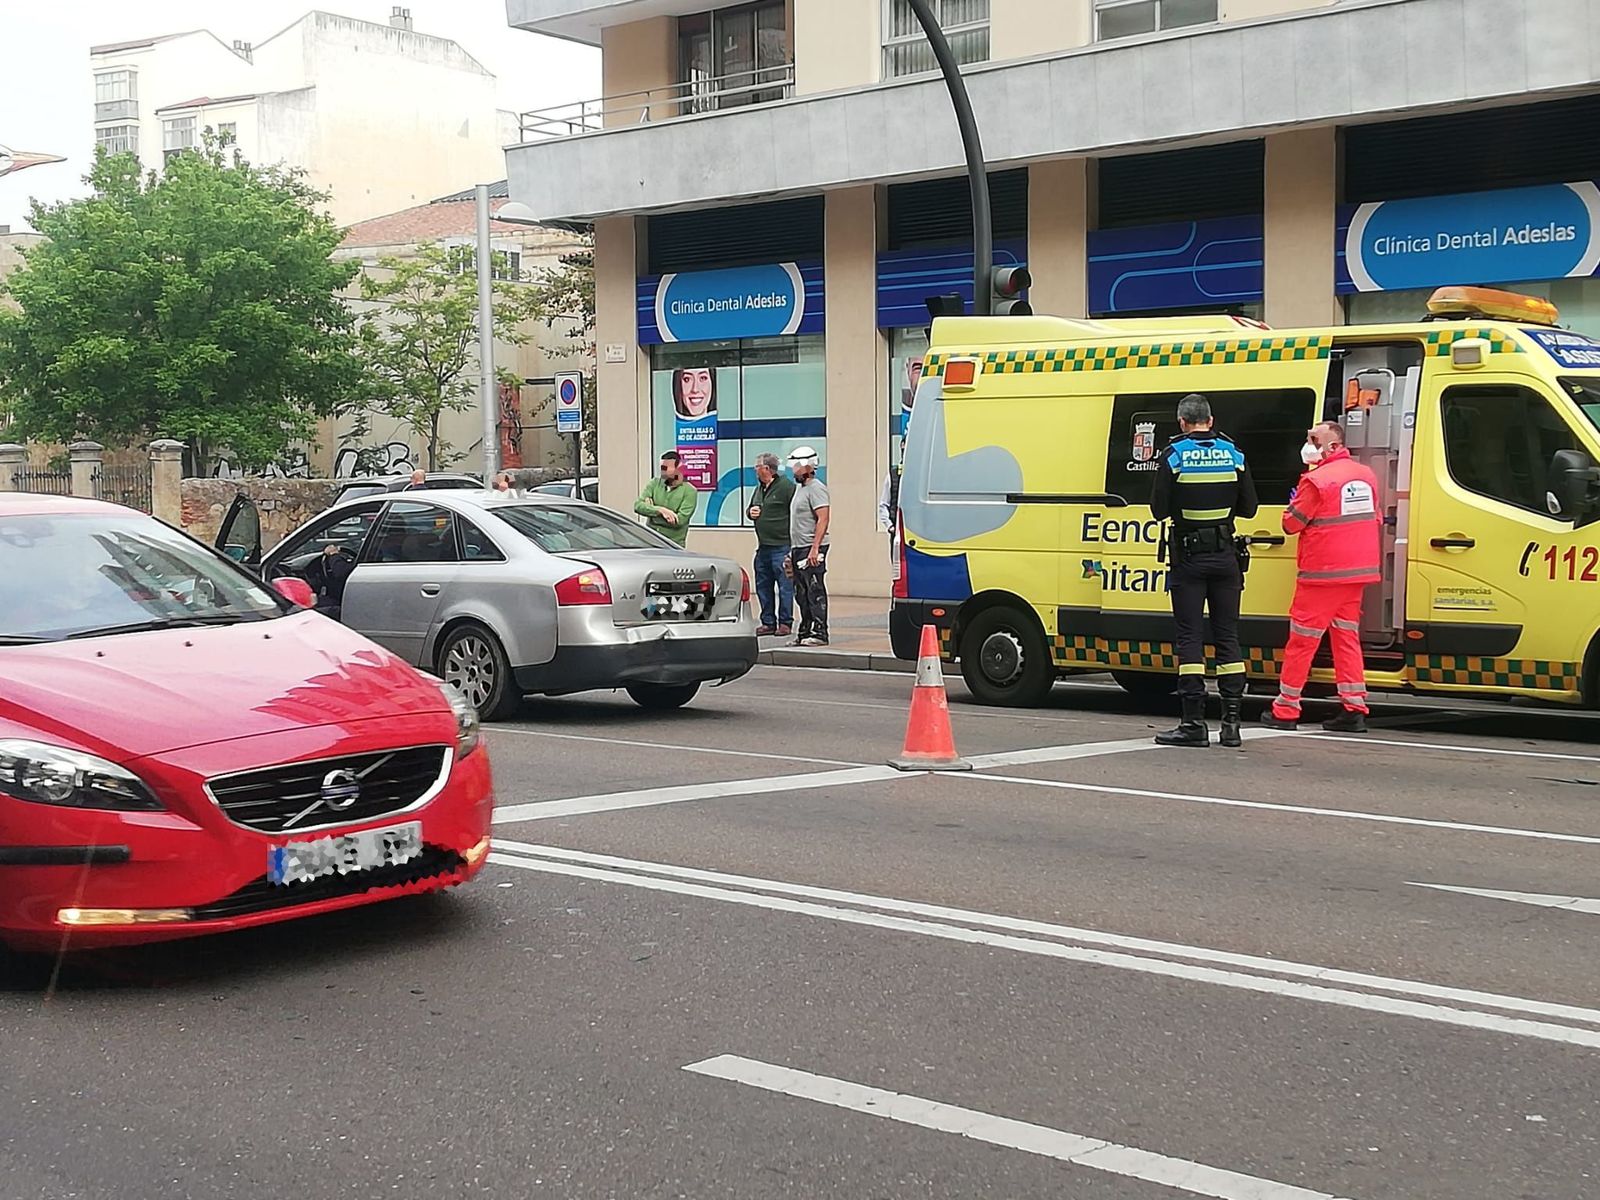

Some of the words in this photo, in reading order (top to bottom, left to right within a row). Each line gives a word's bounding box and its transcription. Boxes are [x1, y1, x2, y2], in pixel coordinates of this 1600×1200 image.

[1374, 235, 1431, 256] Clínica
[1437, 227, 1498, 250] Dental
[1502, 222, 1576, 246] Adeslas
[671, 300, 705, 315] Clínica
[707, 295, 743, 312] Dental
[745, 292, 787, 310] Adeslas
[1182, 460, 1234, 468] SALAMANCA
[1543, 545, 1599, 581] 112
[1437, 586, 1492, 596] emergencias
